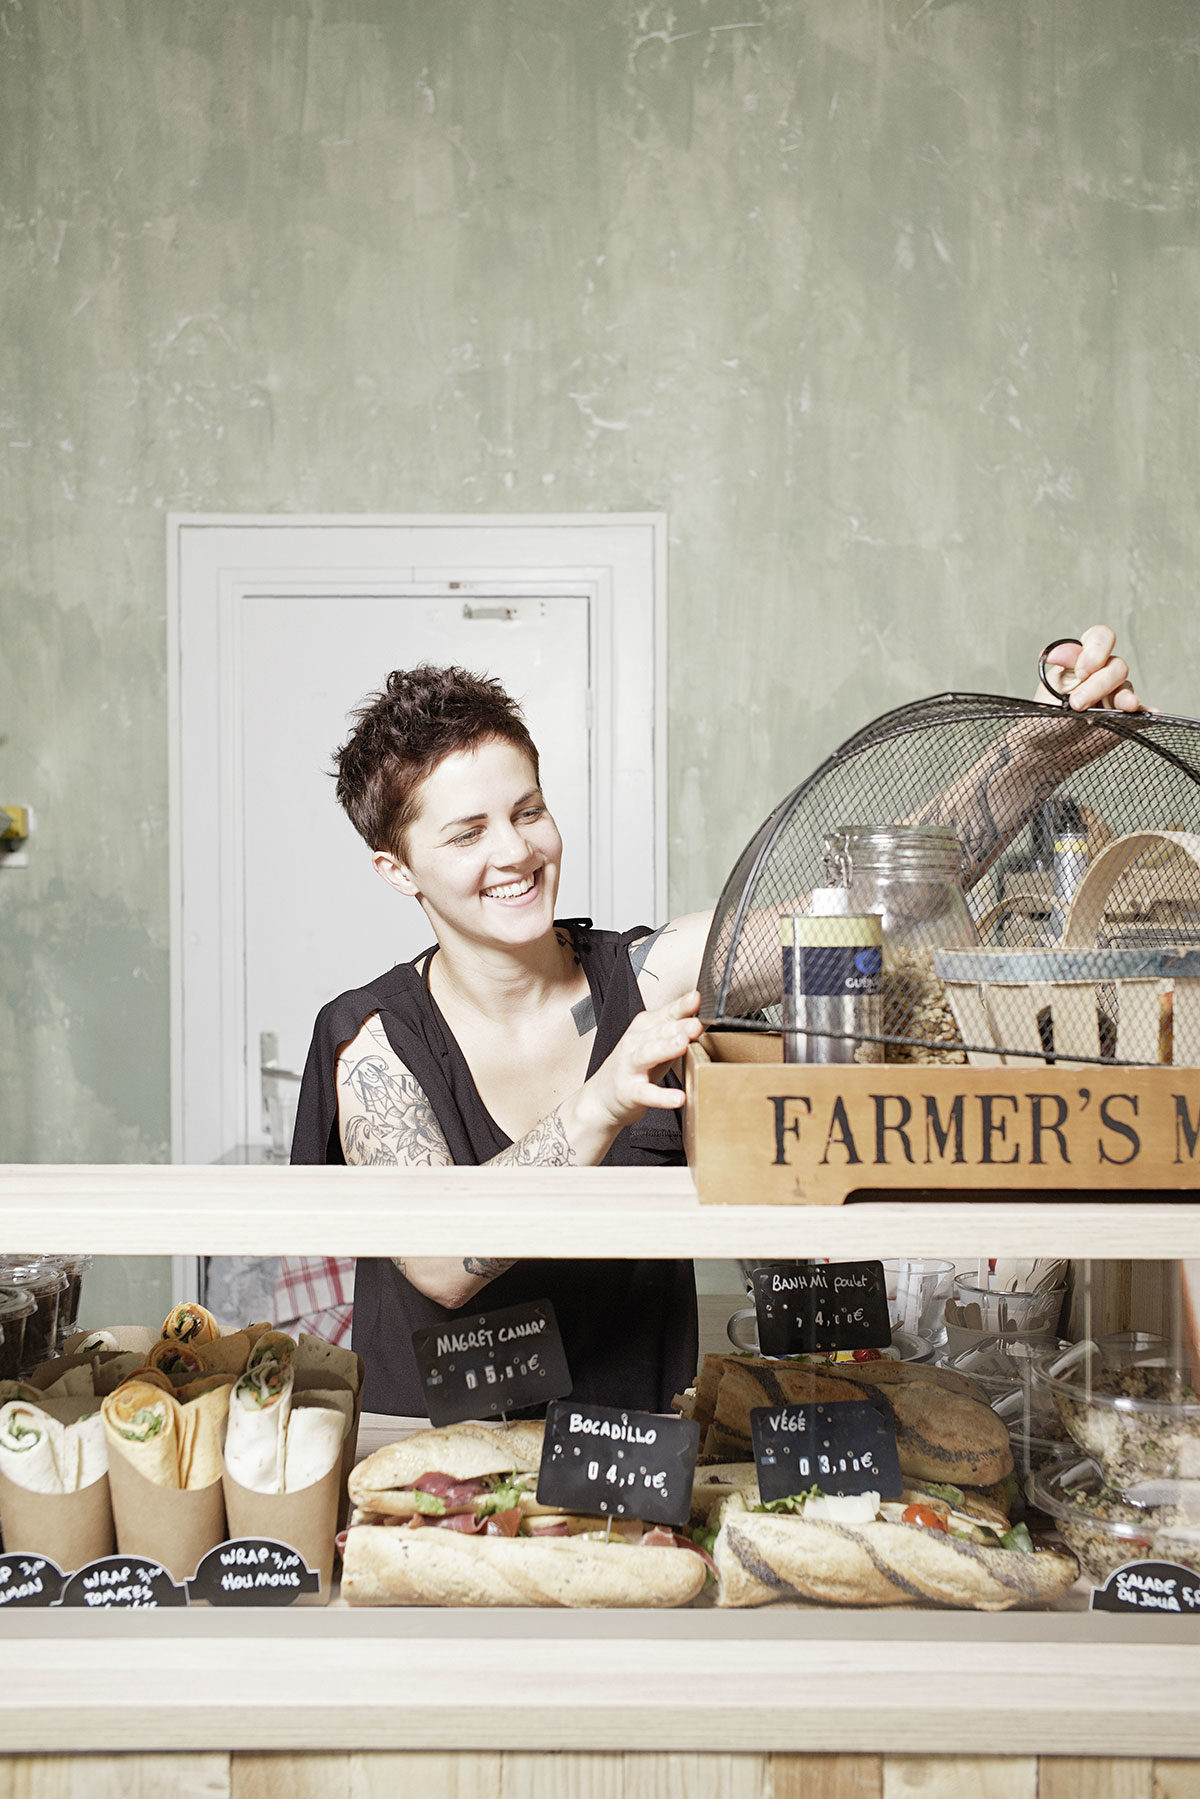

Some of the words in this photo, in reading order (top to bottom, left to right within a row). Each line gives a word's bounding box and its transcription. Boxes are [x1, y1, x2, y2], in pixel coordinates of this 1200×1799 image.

[767, 1088, 1141, 1166] FARMER'S
[772, 1274, 807, 1292] BANH
[437, 1329, 494, 1357] MAGRET
[569, 1413, 657, 1445] BOCADILLO
[220, 1547, 270, 1566] WRAP
[83, 1566, 131, 1589] WRAP
[1116, 1572, 1177, 1595] SALADE
[84, 1585, 153, 1606] TOMATES
[1117, 1588, 1138, 1604] DU
